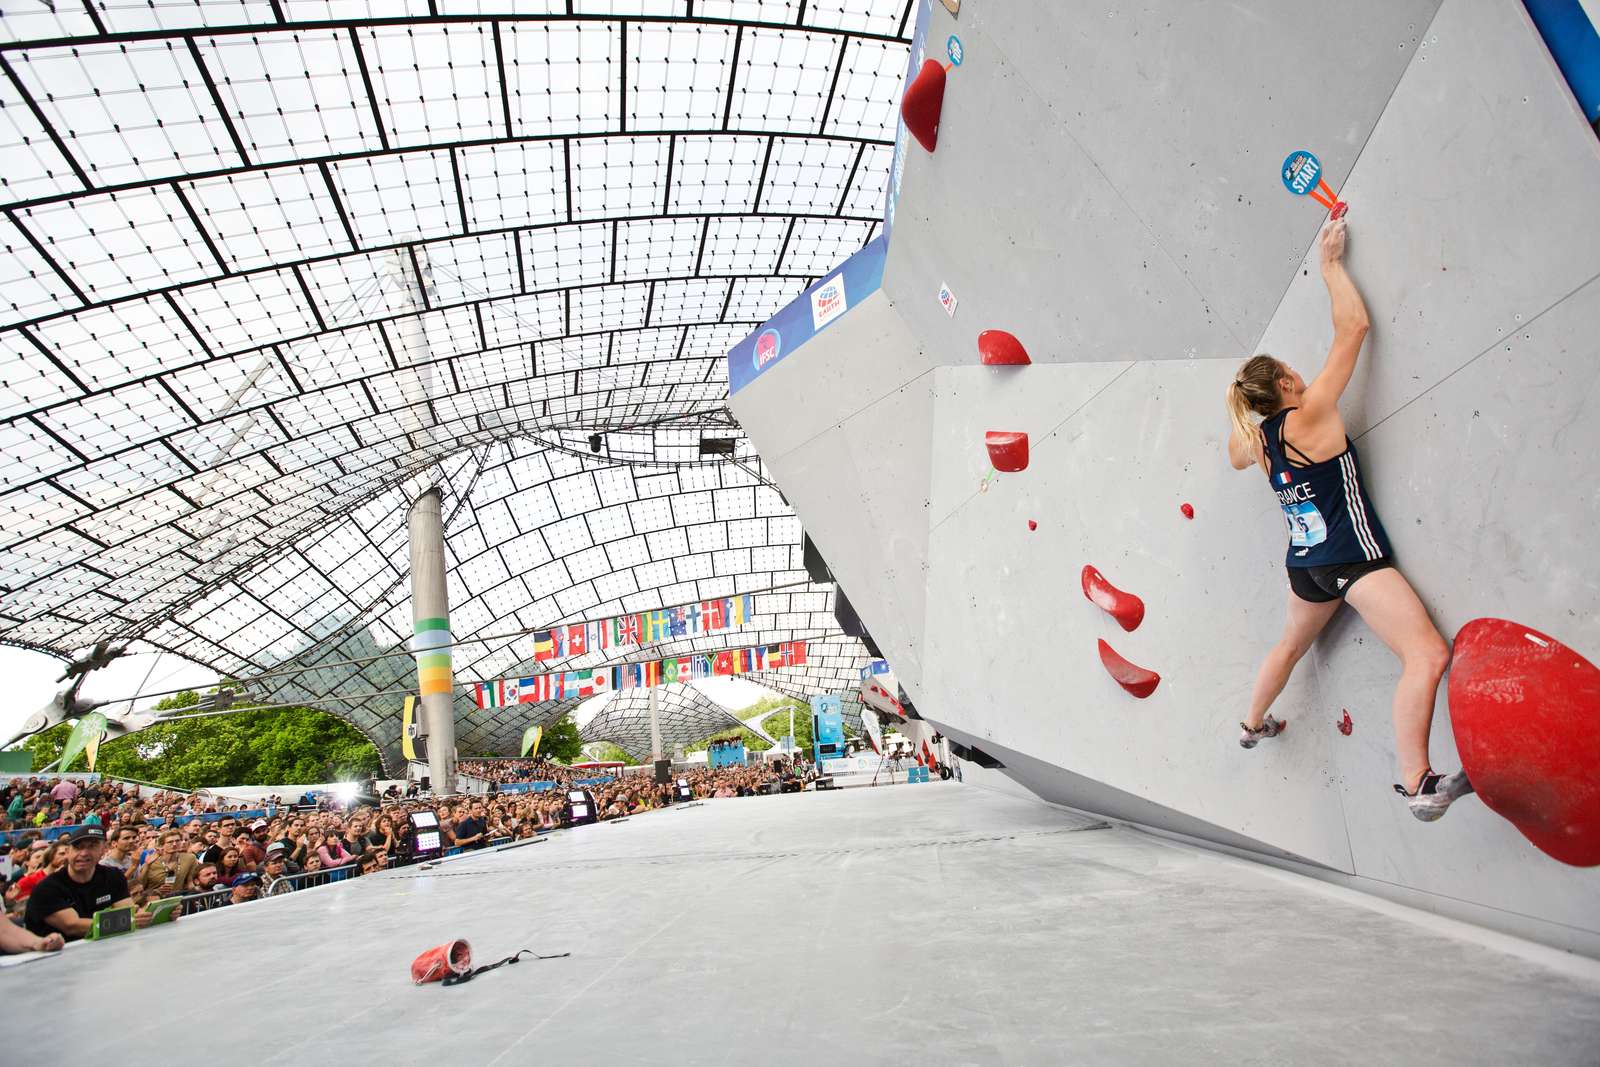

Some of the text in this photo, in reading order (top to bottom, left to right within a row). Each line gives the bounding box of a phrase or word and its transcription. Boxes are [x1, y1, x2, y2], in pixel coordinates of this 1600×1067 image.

[1292, 157, 1319, 193] START
[759, 346, 775, 366] IFSC
[1277, 482, 1316, 505] RANCE
